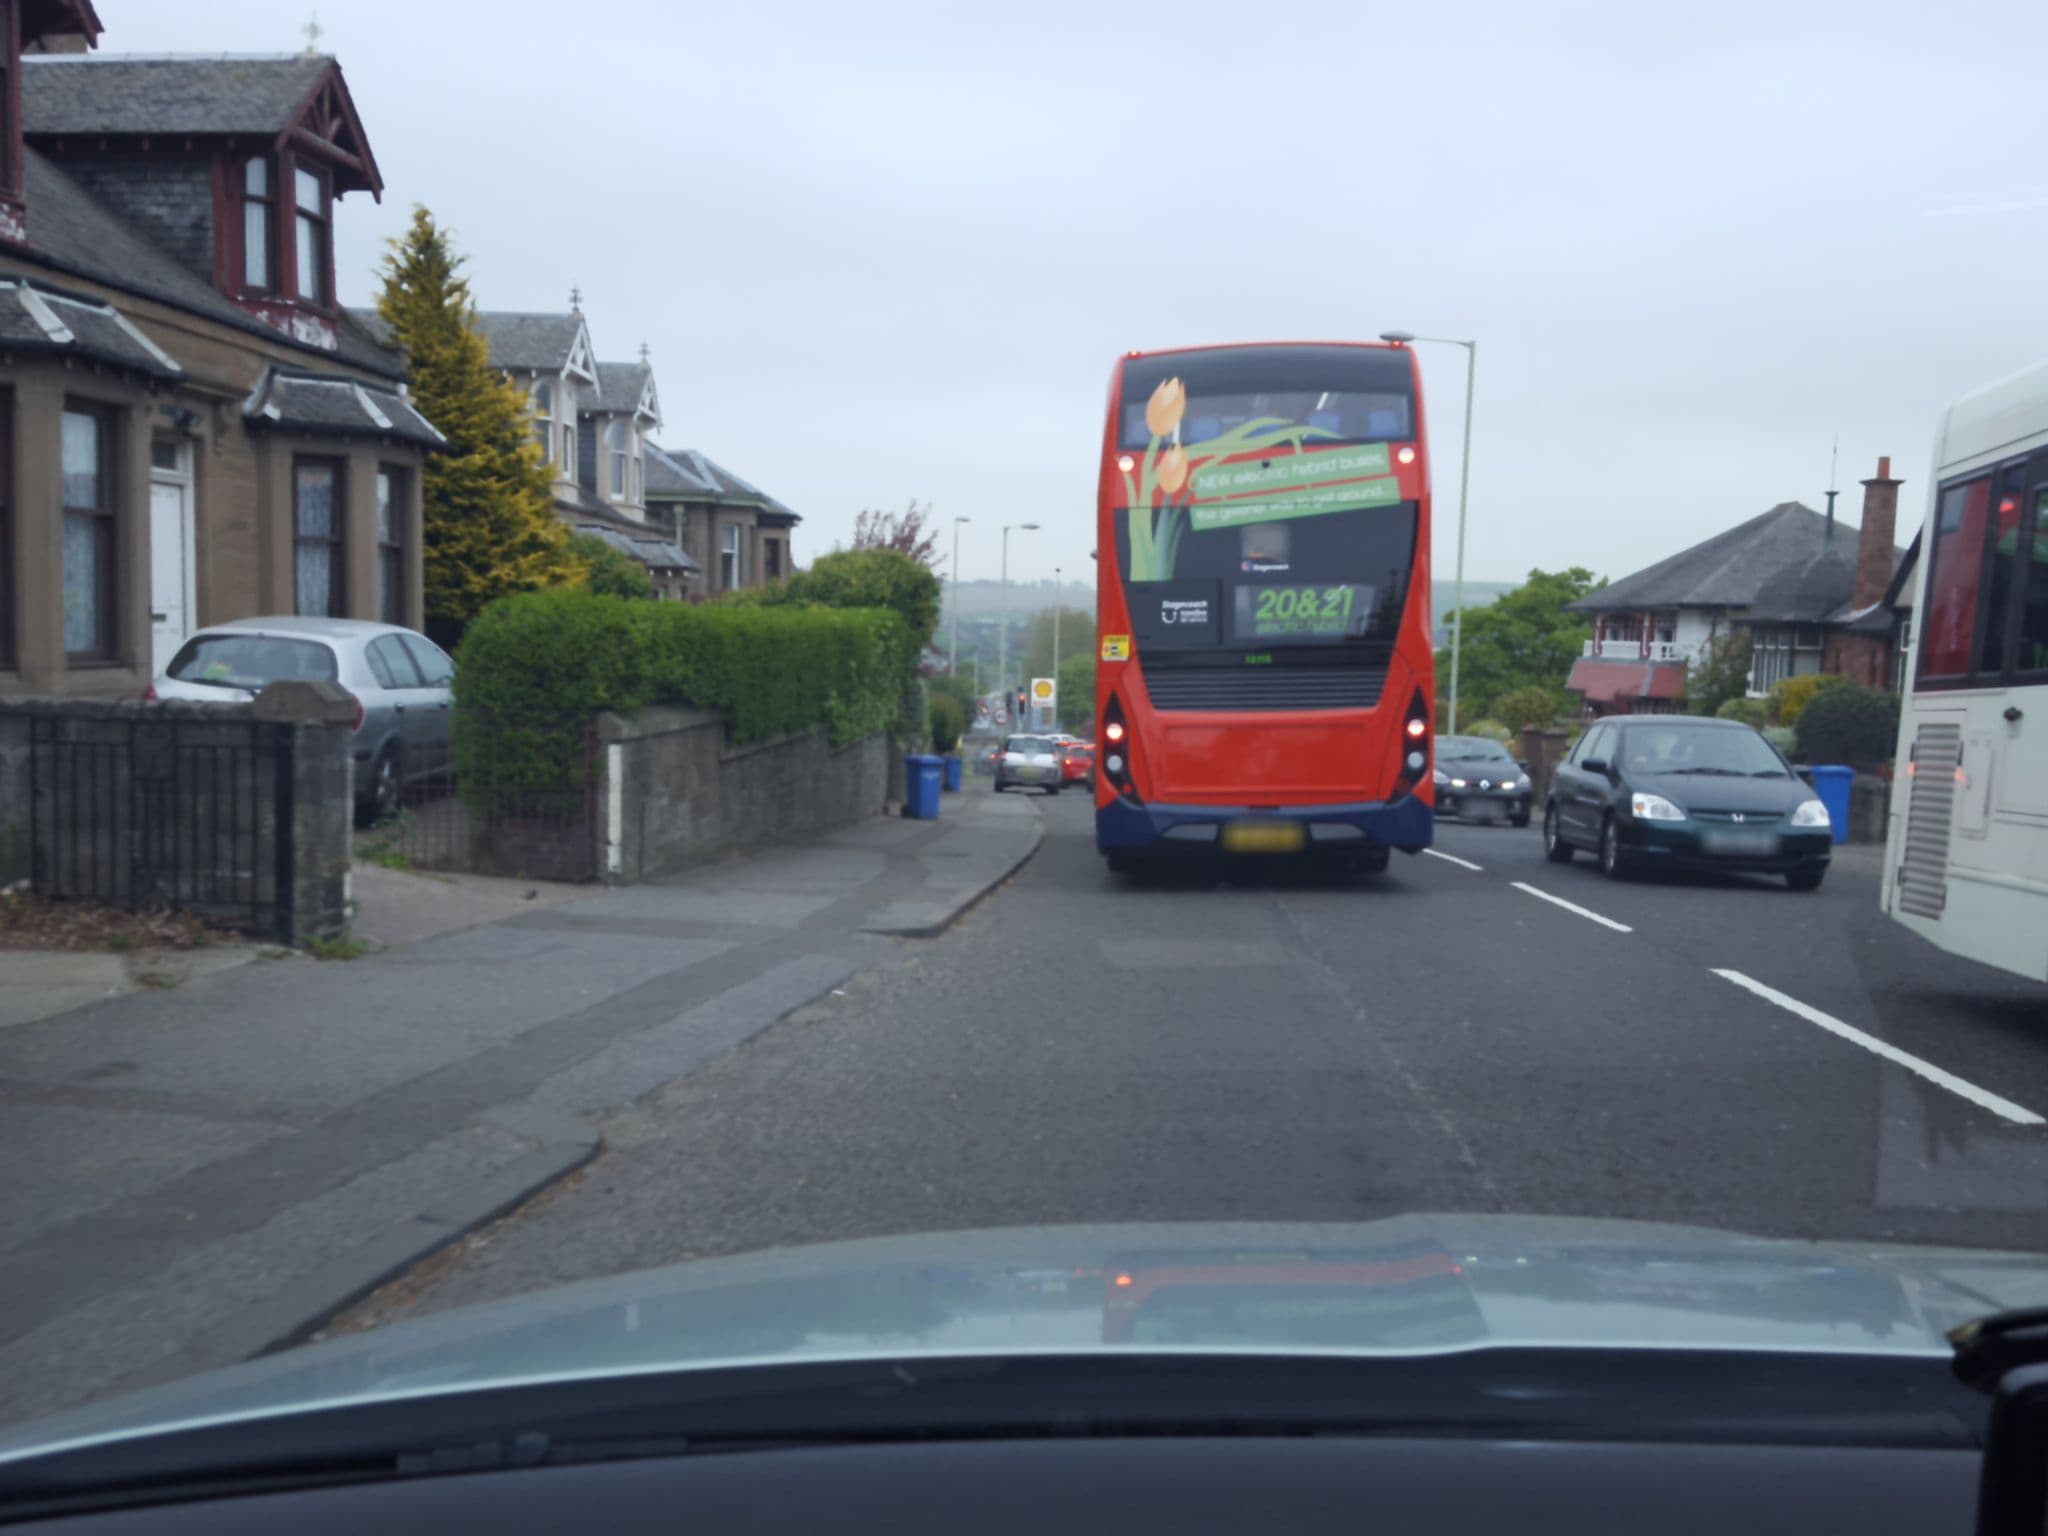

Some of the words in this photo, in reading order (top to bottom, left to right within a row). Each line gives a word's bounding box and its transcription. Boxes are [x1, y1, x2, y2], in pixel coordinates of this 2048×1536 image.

[1198, 473, 1231, 489] NEW
[1293, 458, 1336, 476] hybrid
[1255, 588, 1354, 620] 20&21
